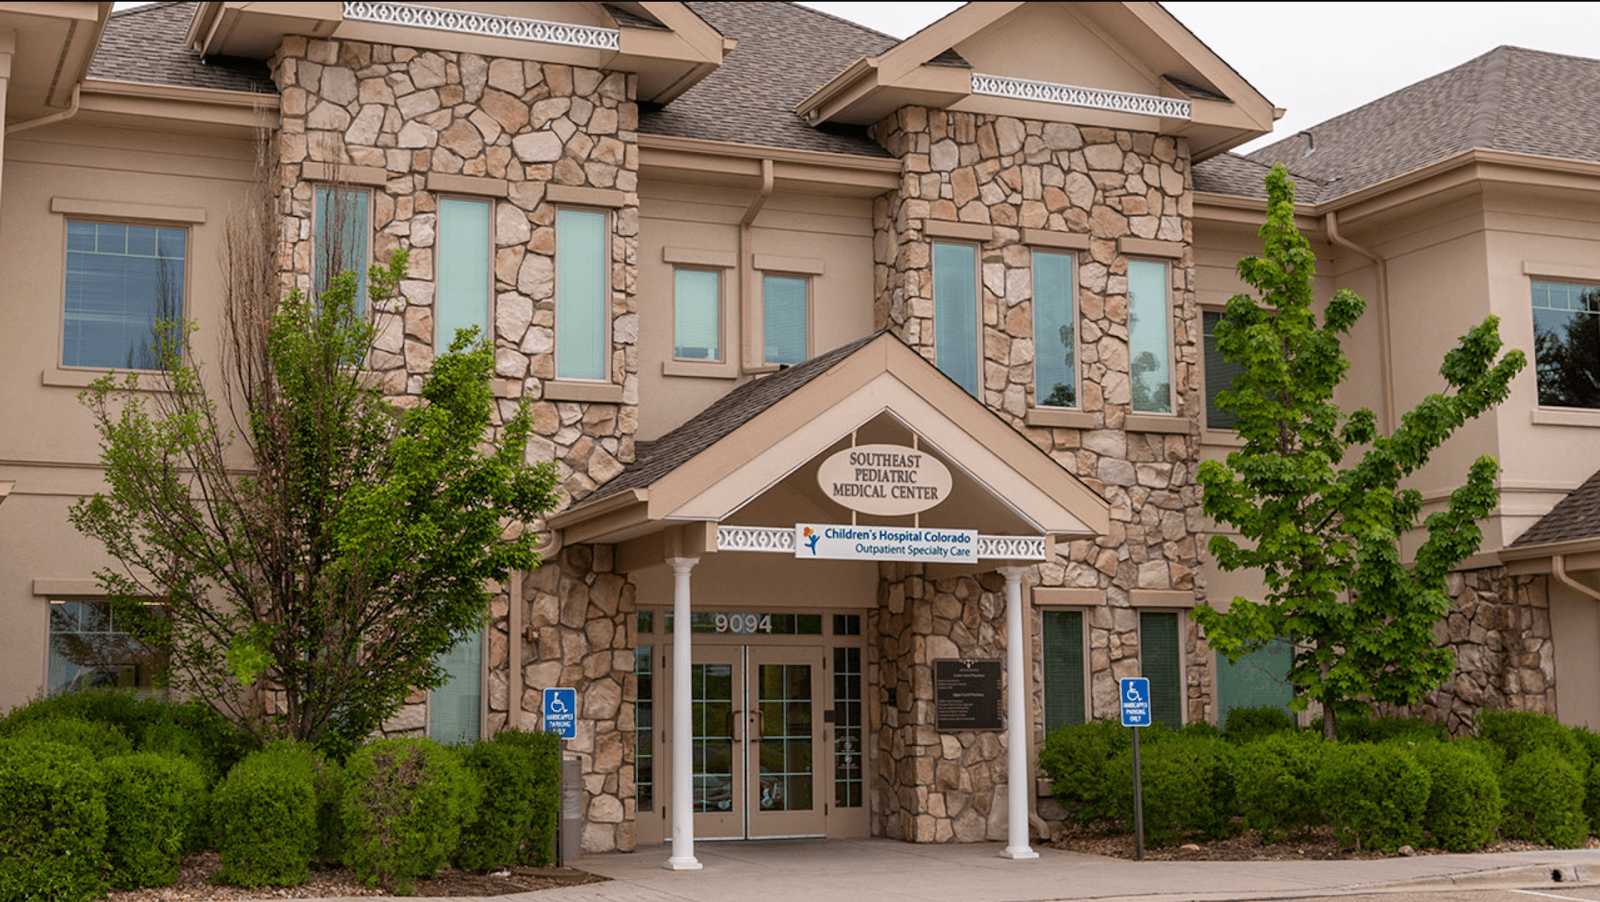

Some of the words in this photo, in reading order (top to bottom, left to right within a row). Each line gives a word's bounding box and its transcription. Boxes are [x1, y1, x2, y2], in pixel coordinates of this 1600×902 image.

[850, 452, 922, 468] SOUTHEAST
[855, 468, 917, 483] PEDIATRIC
[833, 483, 887, 498] MEDICAL
[891, 485, 938, 500] CENTER
[825, 528, 877, 541] Children's
[879, 530, 922, 544] Hospital
[924, 531, 971, 544] Colorado
[855, 543, 906, 556] Outpatient
[907, 545, 949, 558] Specialty
[950, 546, 971, 557] Care
[715, 614, 772, 633] 9094
